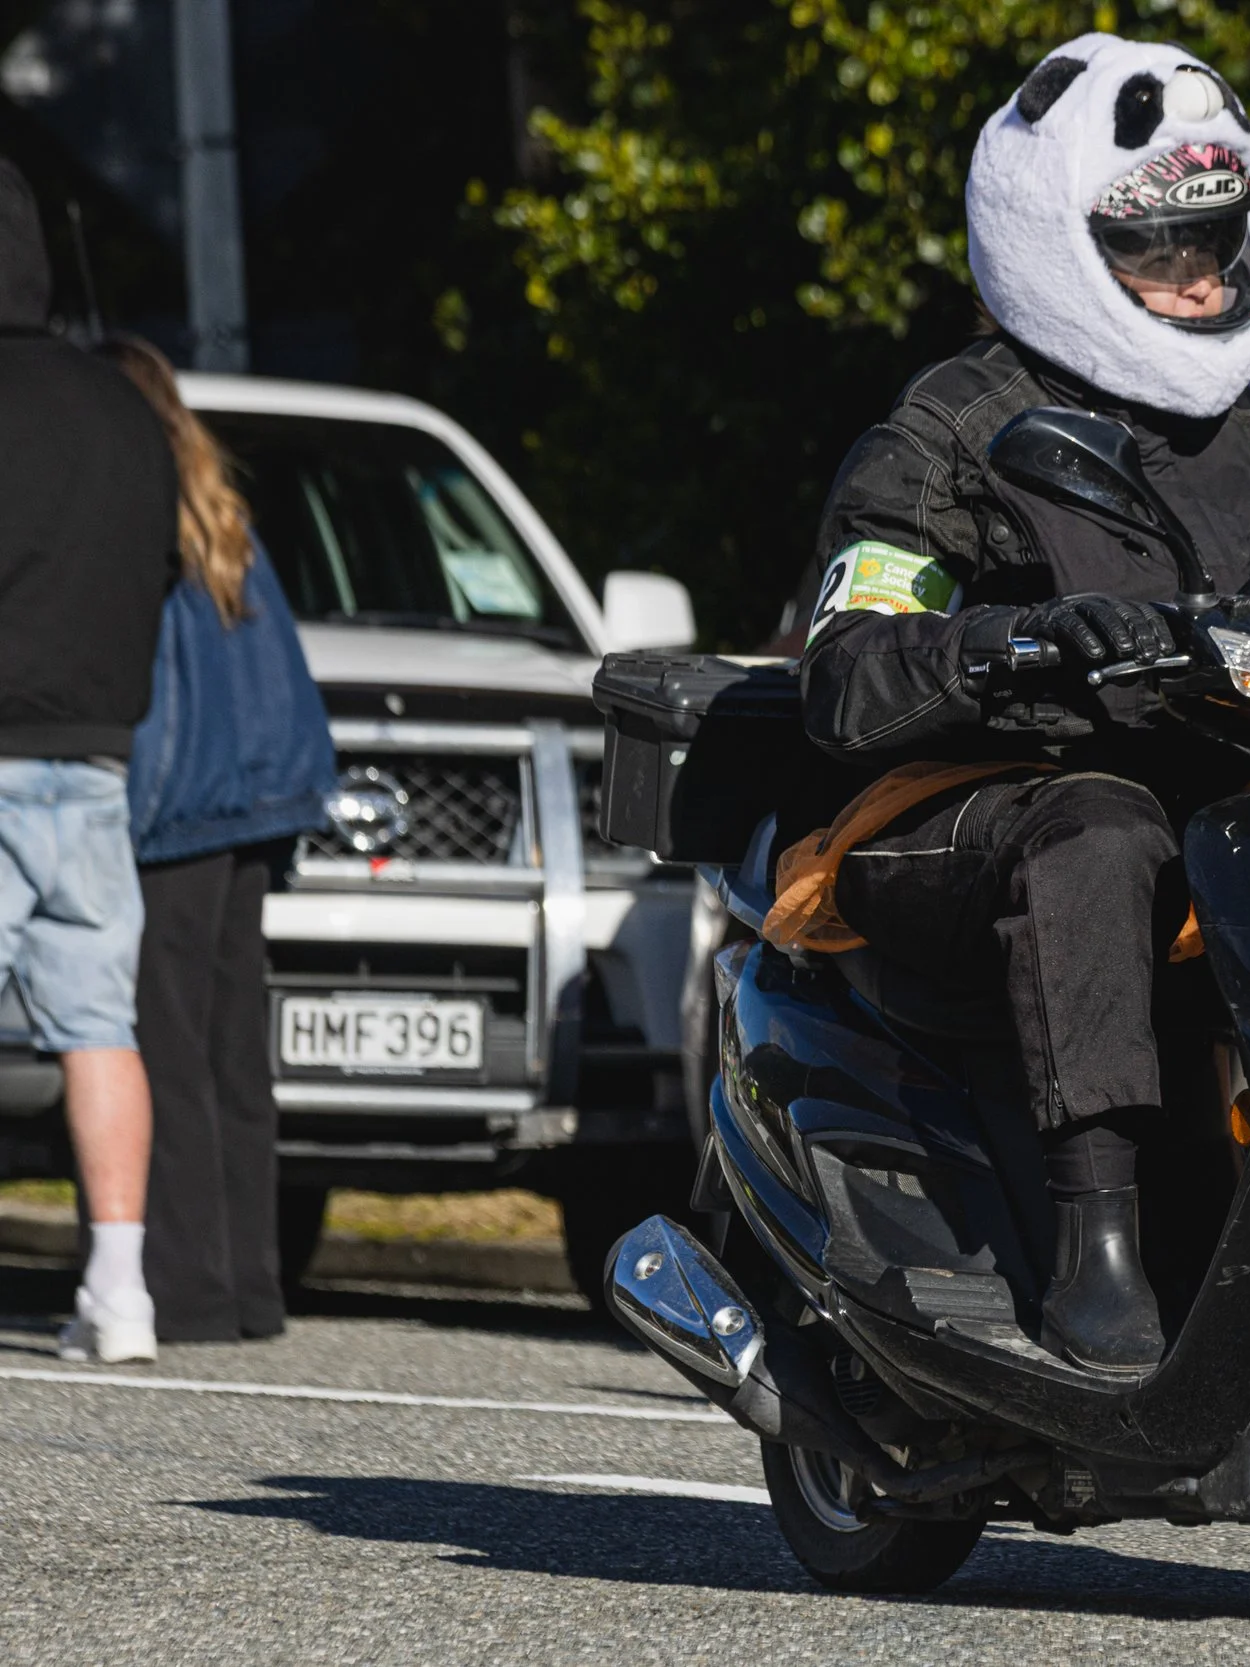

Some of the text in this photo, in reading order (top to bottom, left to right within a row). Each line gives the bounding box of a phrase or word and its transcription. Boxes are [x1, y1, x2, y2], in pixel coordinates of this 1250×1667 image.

[1185, 178, 1236, 201] HJC
[883, 562, 926, 583] Cancer
[881, 573, 926, 598] Society
[291, 1010, 473, 1058] HMF396
